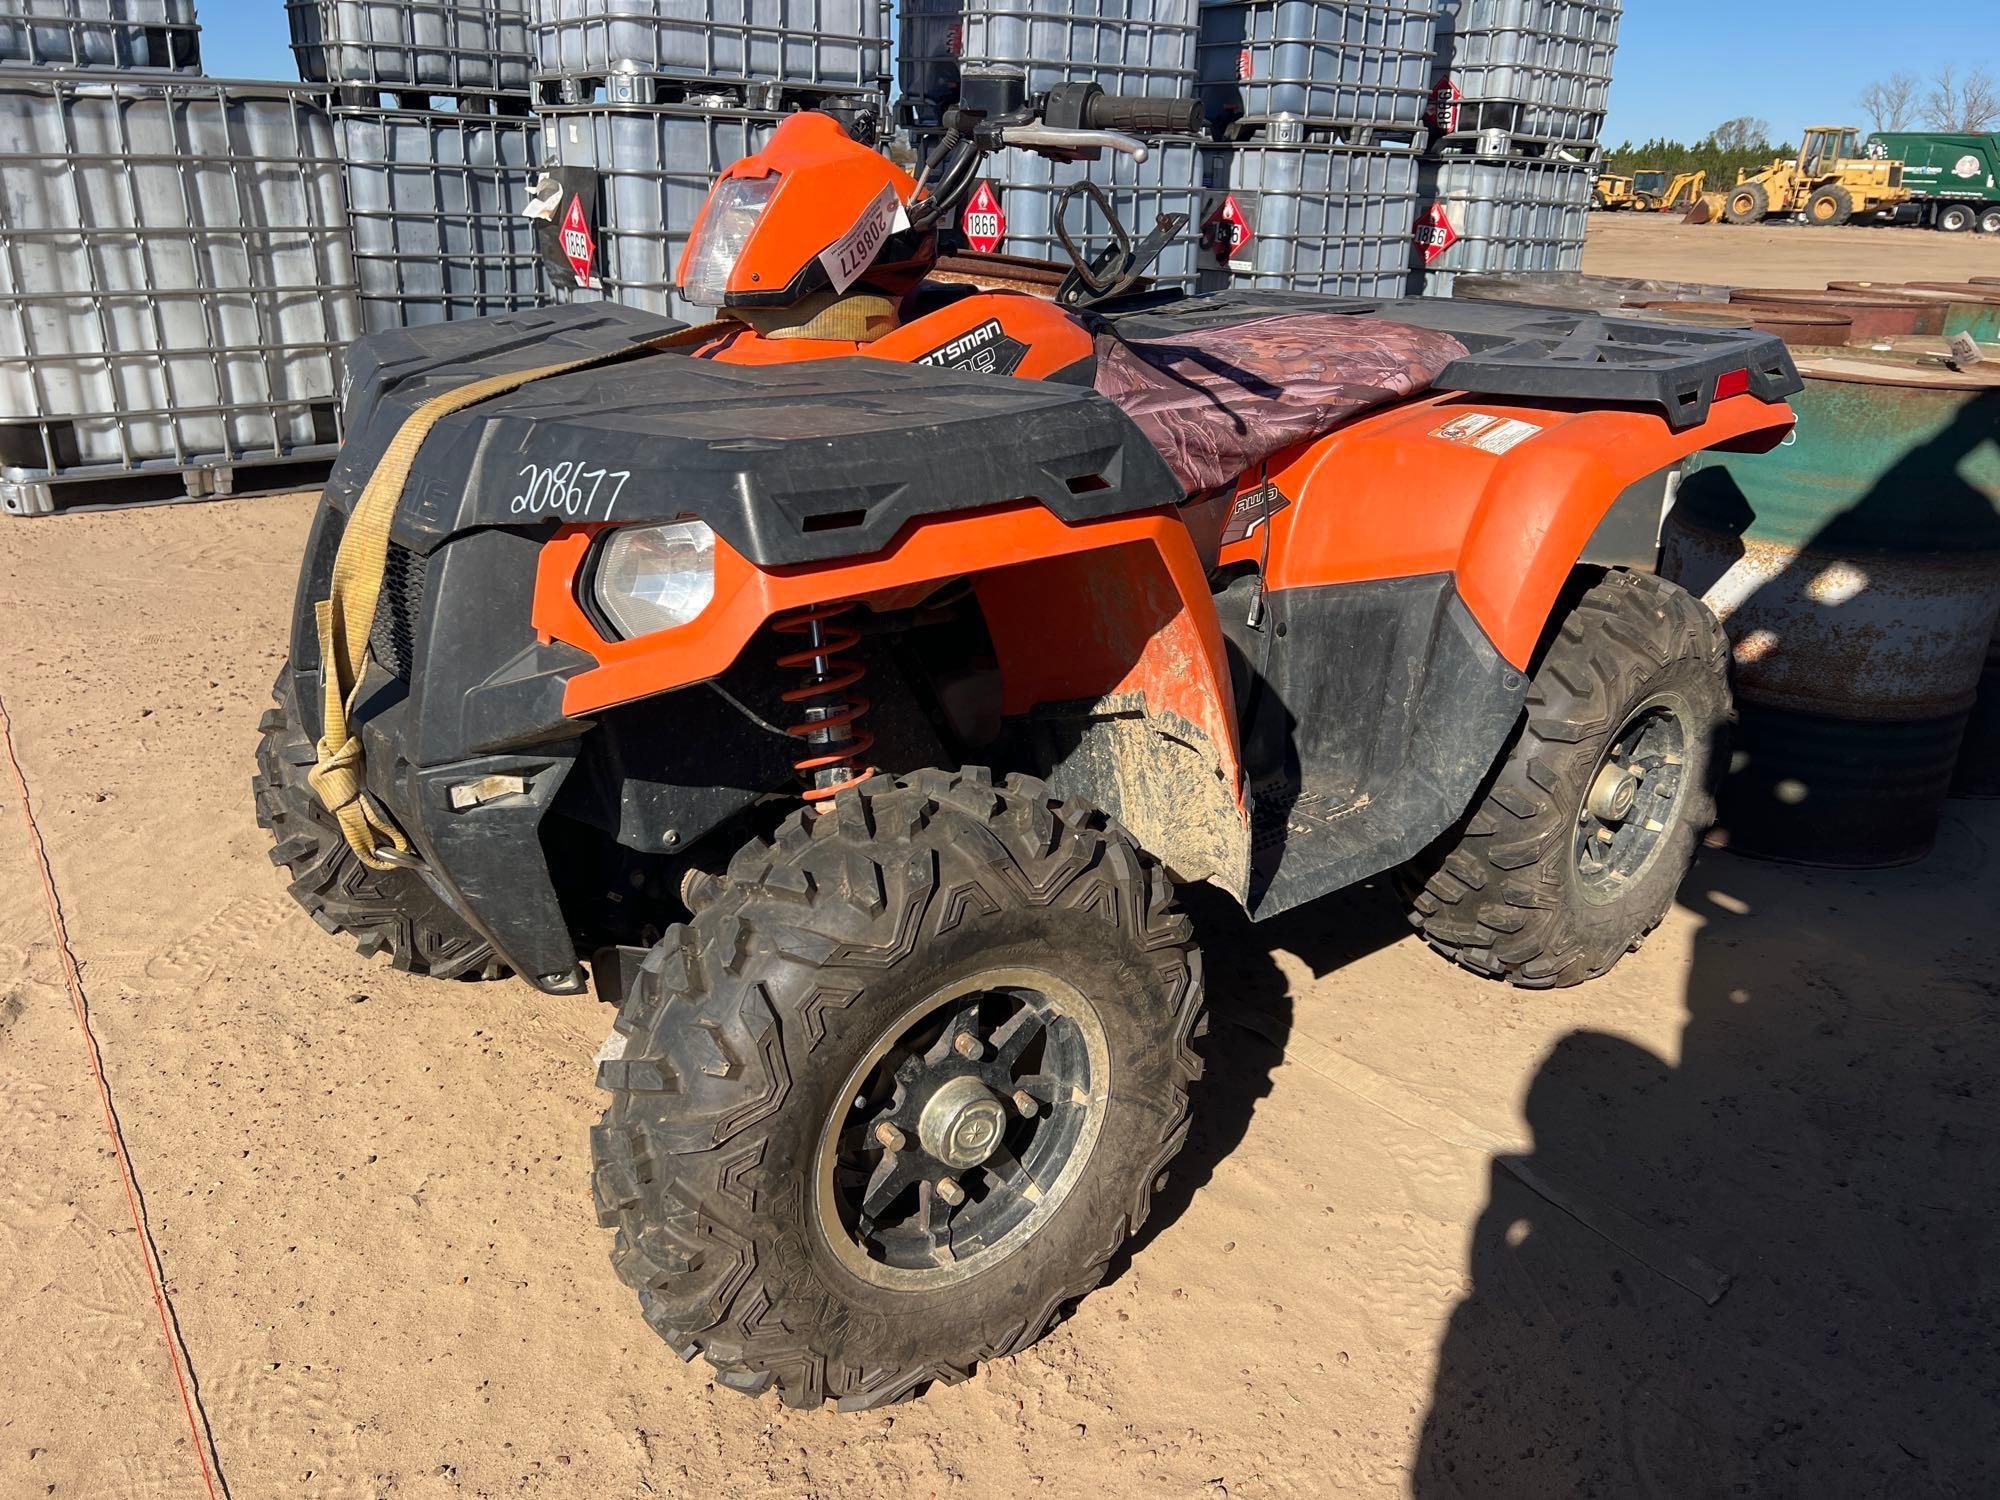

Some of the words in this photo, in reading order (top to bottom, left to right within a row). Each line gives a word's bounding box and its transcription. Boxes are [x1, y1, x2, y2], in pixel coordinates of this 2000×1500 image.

[969, 214, 996, 235] 1866
[1417, 227, 1445, 245] 1866
[566, 231, 587, 259] 1866
[840, 210, 886, 278] 208677
[1424, 250, 1430, 260] 3
[510, 461, 631, 521] 208677
[1234, 487, 1278, 515] AWD
